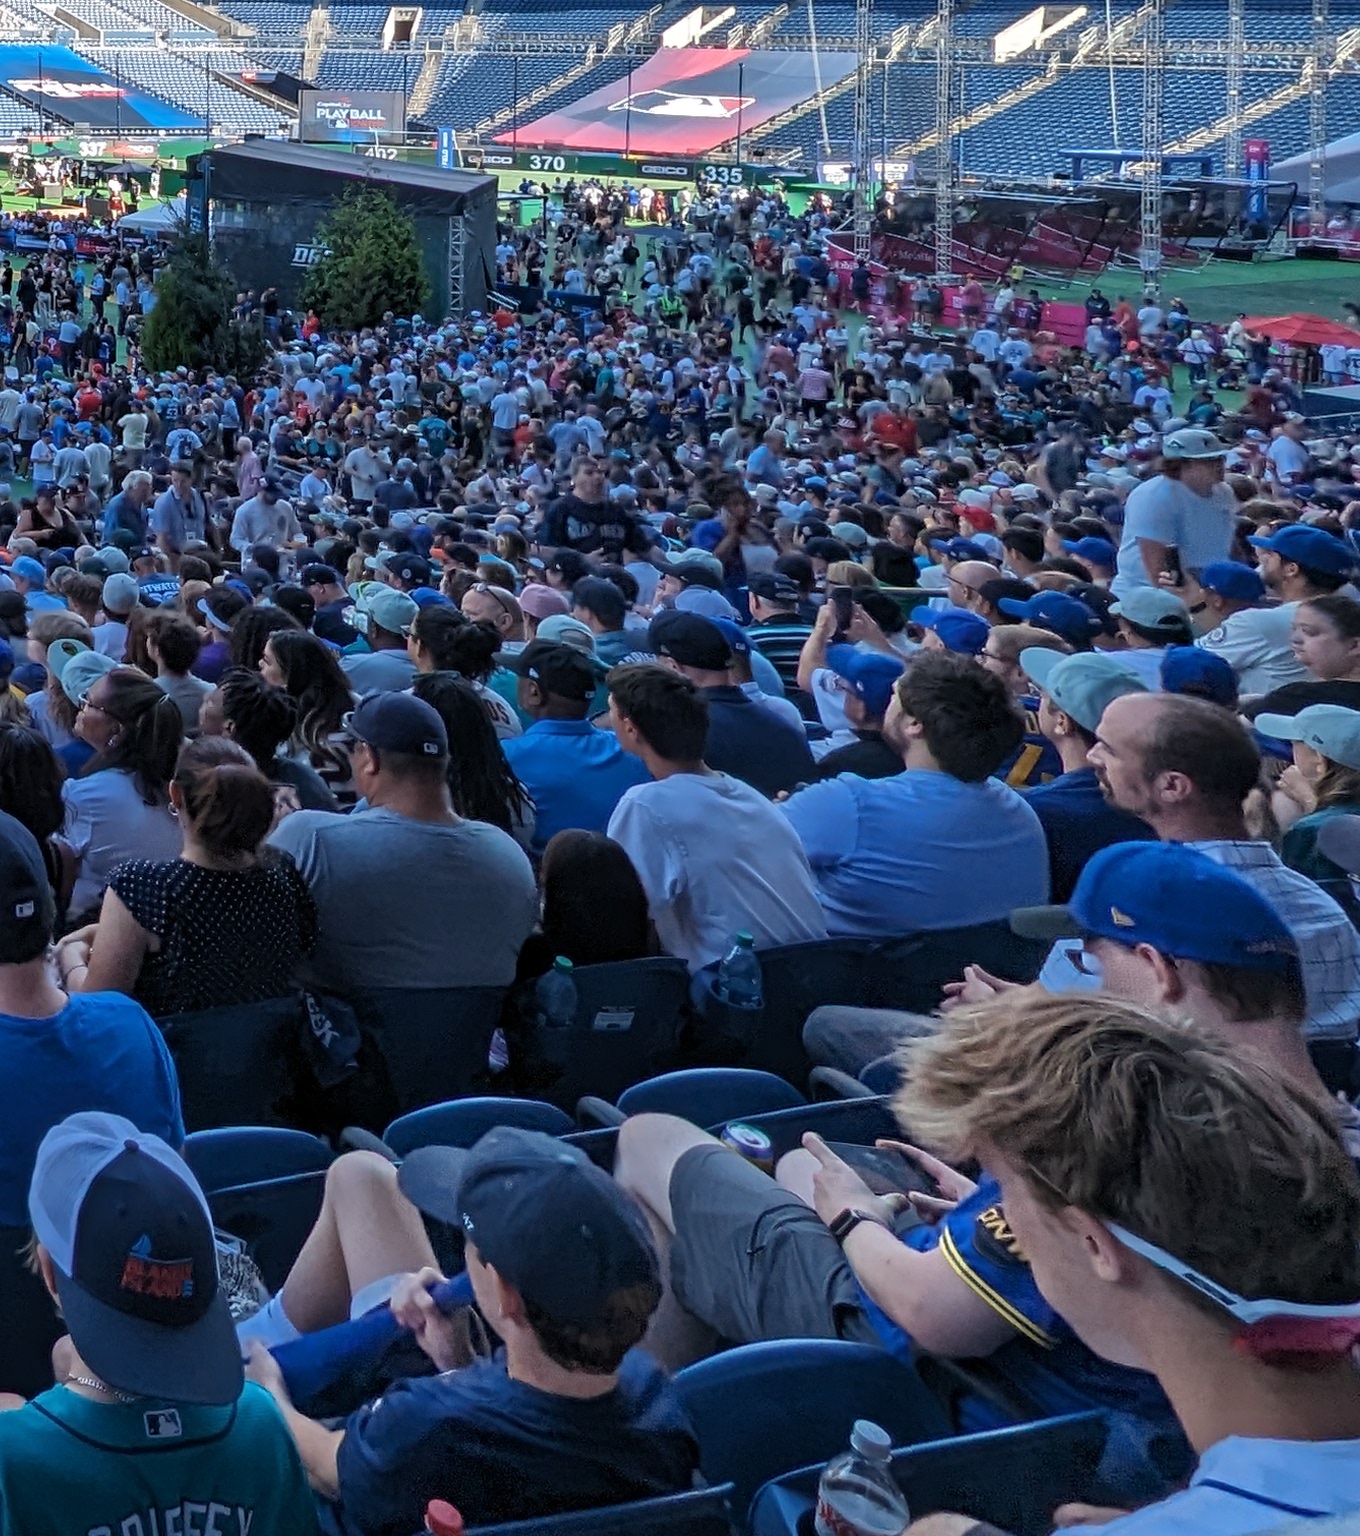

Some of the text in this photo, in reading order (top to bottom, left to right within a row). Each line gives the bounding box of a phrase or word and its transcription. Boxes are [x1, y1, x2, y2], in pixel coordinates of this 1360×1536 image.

[350, 109, 387, 121] BALL
[78, 142, 107, 157] 337
[365, 147, 398, 160] 402
[530, 155, 566, 171] 370
[641, 165, 688, 176] GEICO
[705, 166, 744, 184] 335
